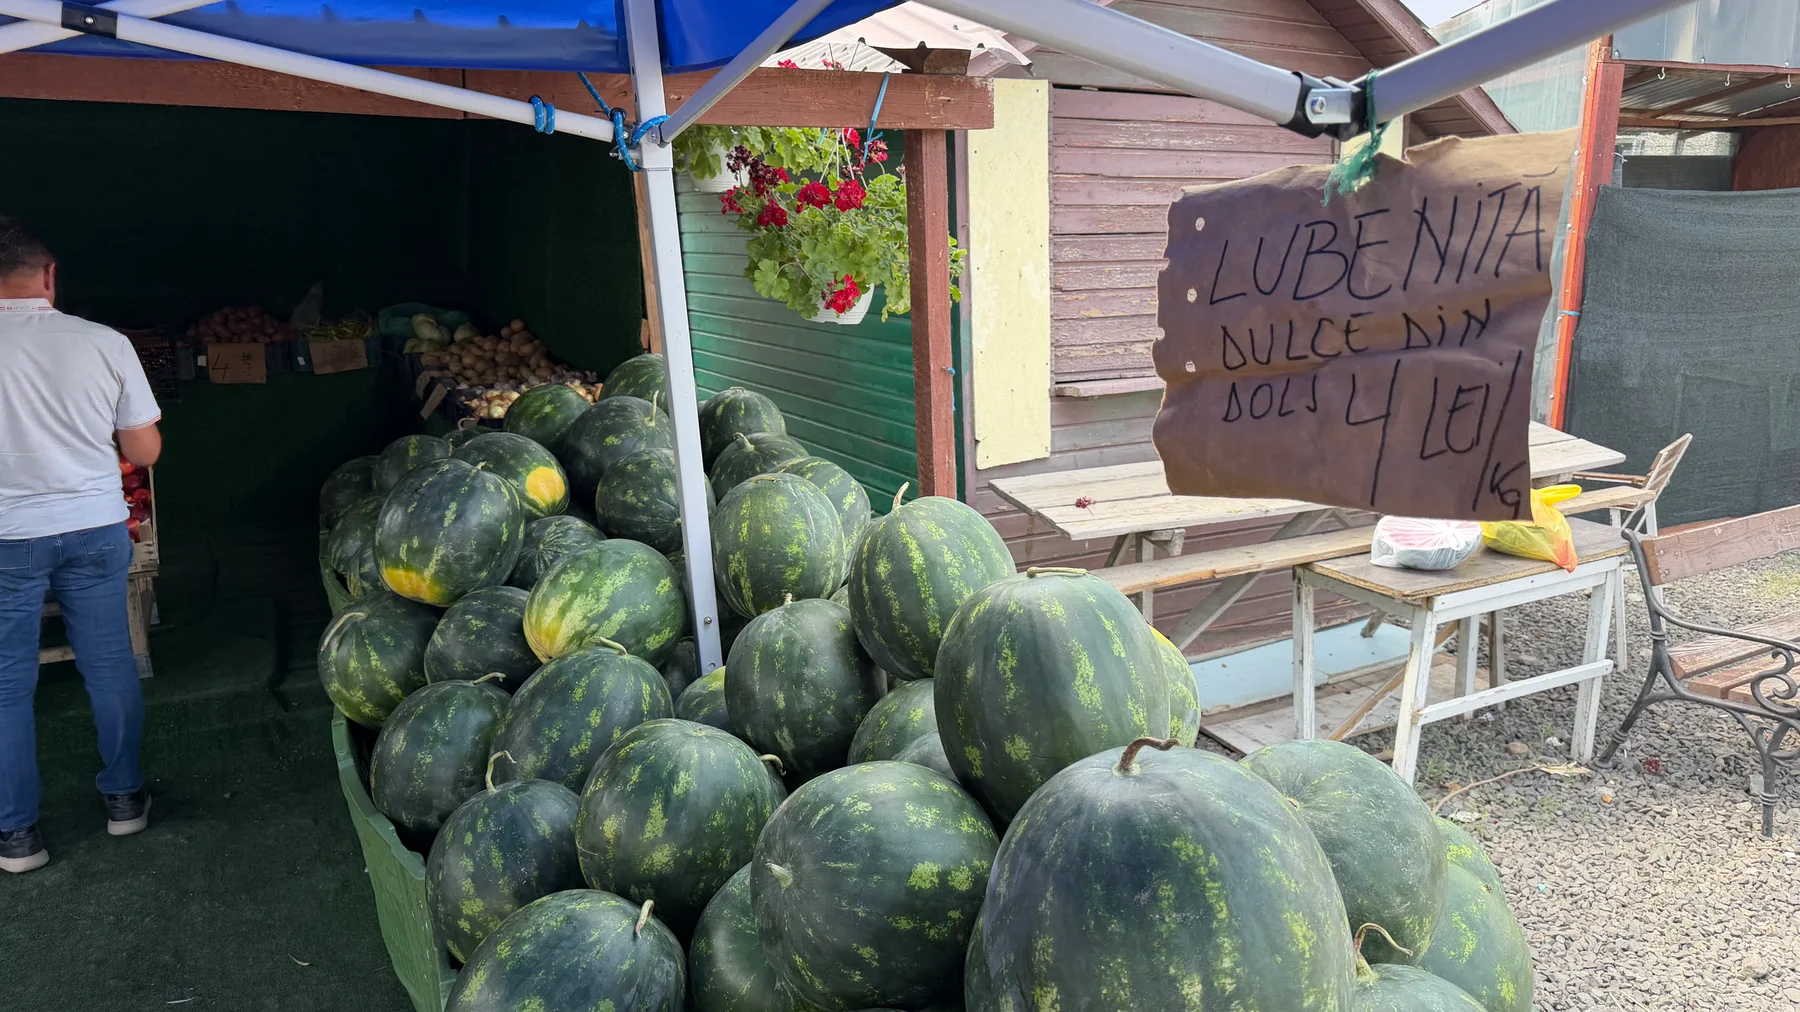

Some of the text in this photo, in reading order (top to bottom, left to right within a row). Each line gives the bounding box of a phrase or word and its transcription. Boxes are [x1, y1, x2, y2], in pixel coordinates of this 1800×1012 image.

[212, 352, 231, 380] 4
[1221, 311, 1374, 371] DULCE
[1222, 373, 1318, 422] DOLJ
[1346, 358, 1401, 507] 4
